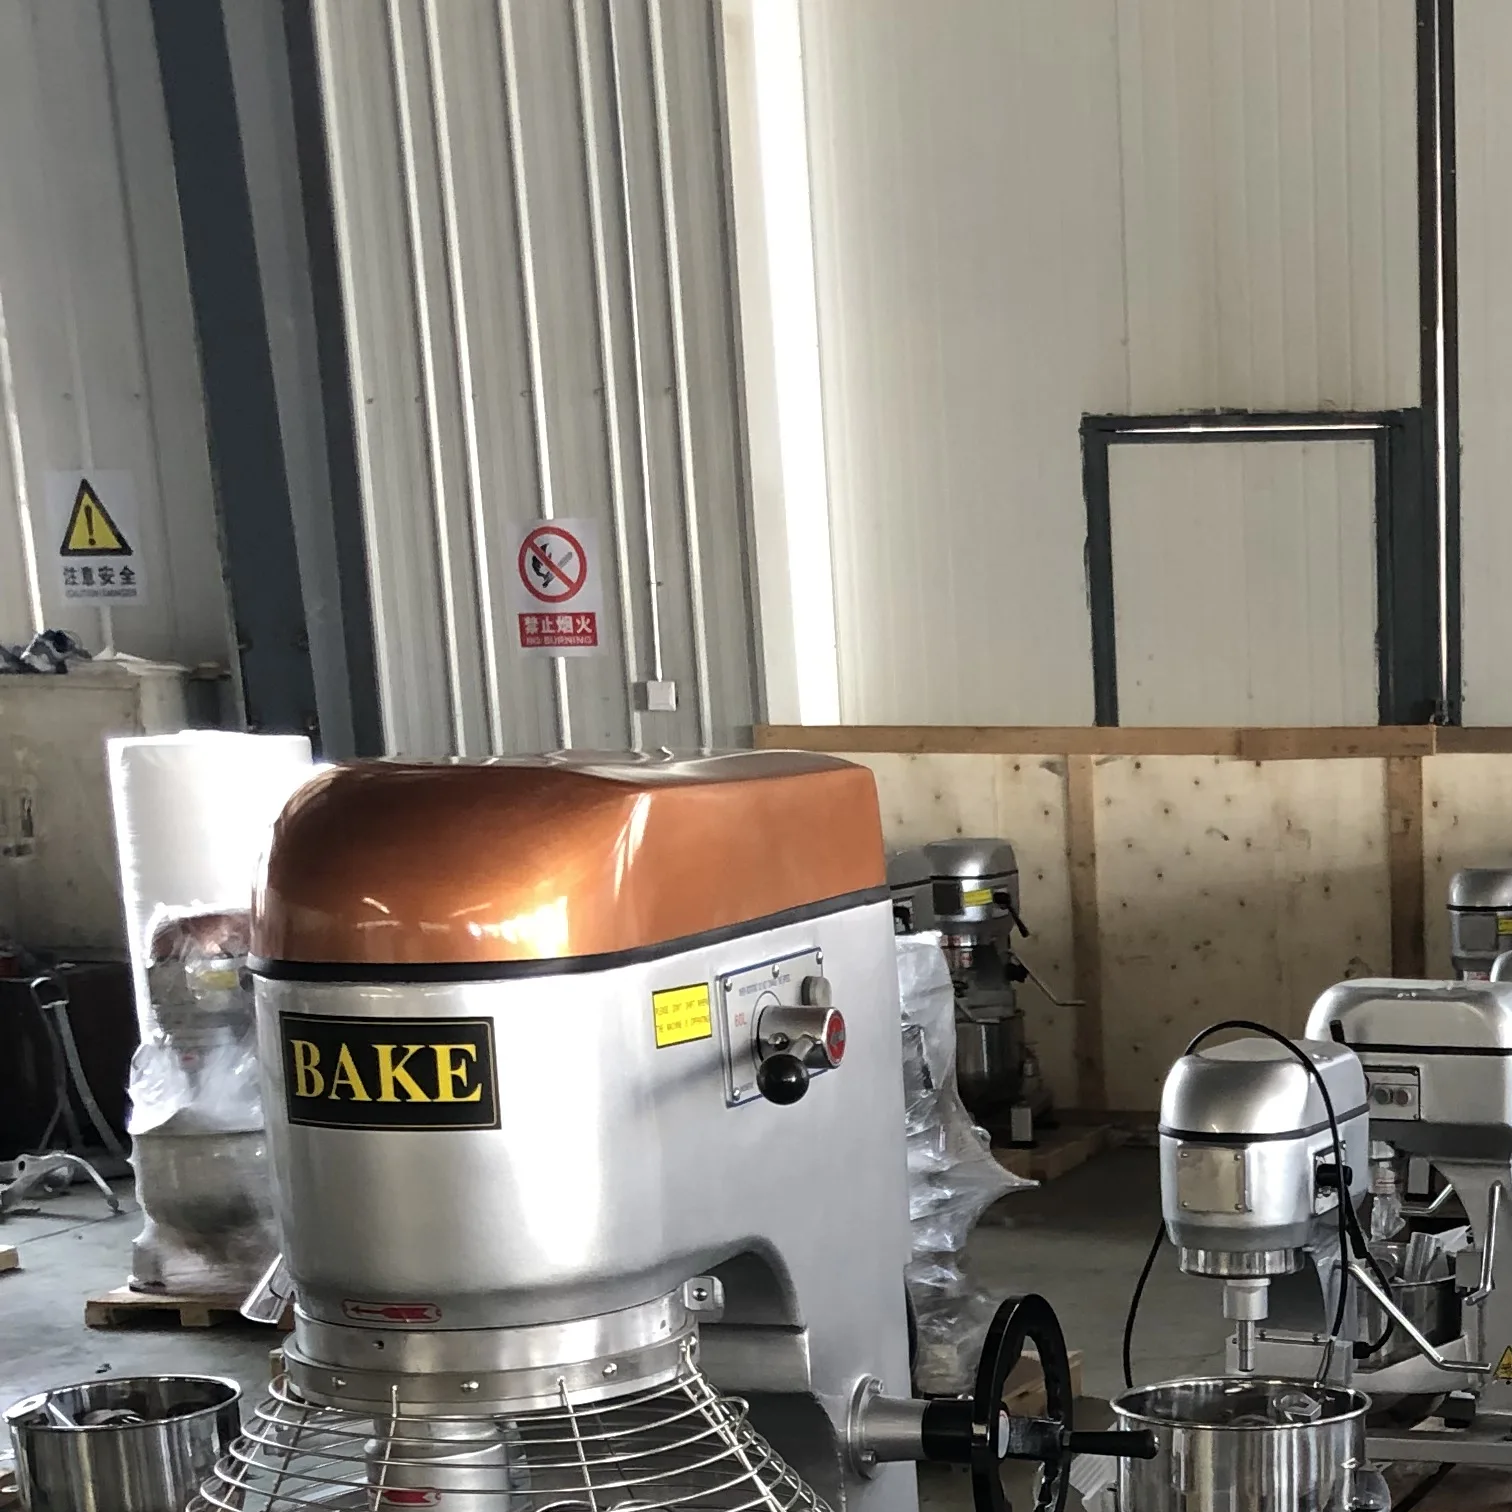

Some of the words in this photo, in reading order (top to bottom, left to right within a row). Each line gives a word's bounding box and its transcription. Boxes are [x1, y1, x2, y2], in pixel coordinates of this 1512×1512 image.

[63, 565, 136, 586] 注意安全
[524, 615, 593, 635] 禁止烟火
[543, 635, 592, 645] BURNING
[290, 1039, 483, 1103] BAKE
